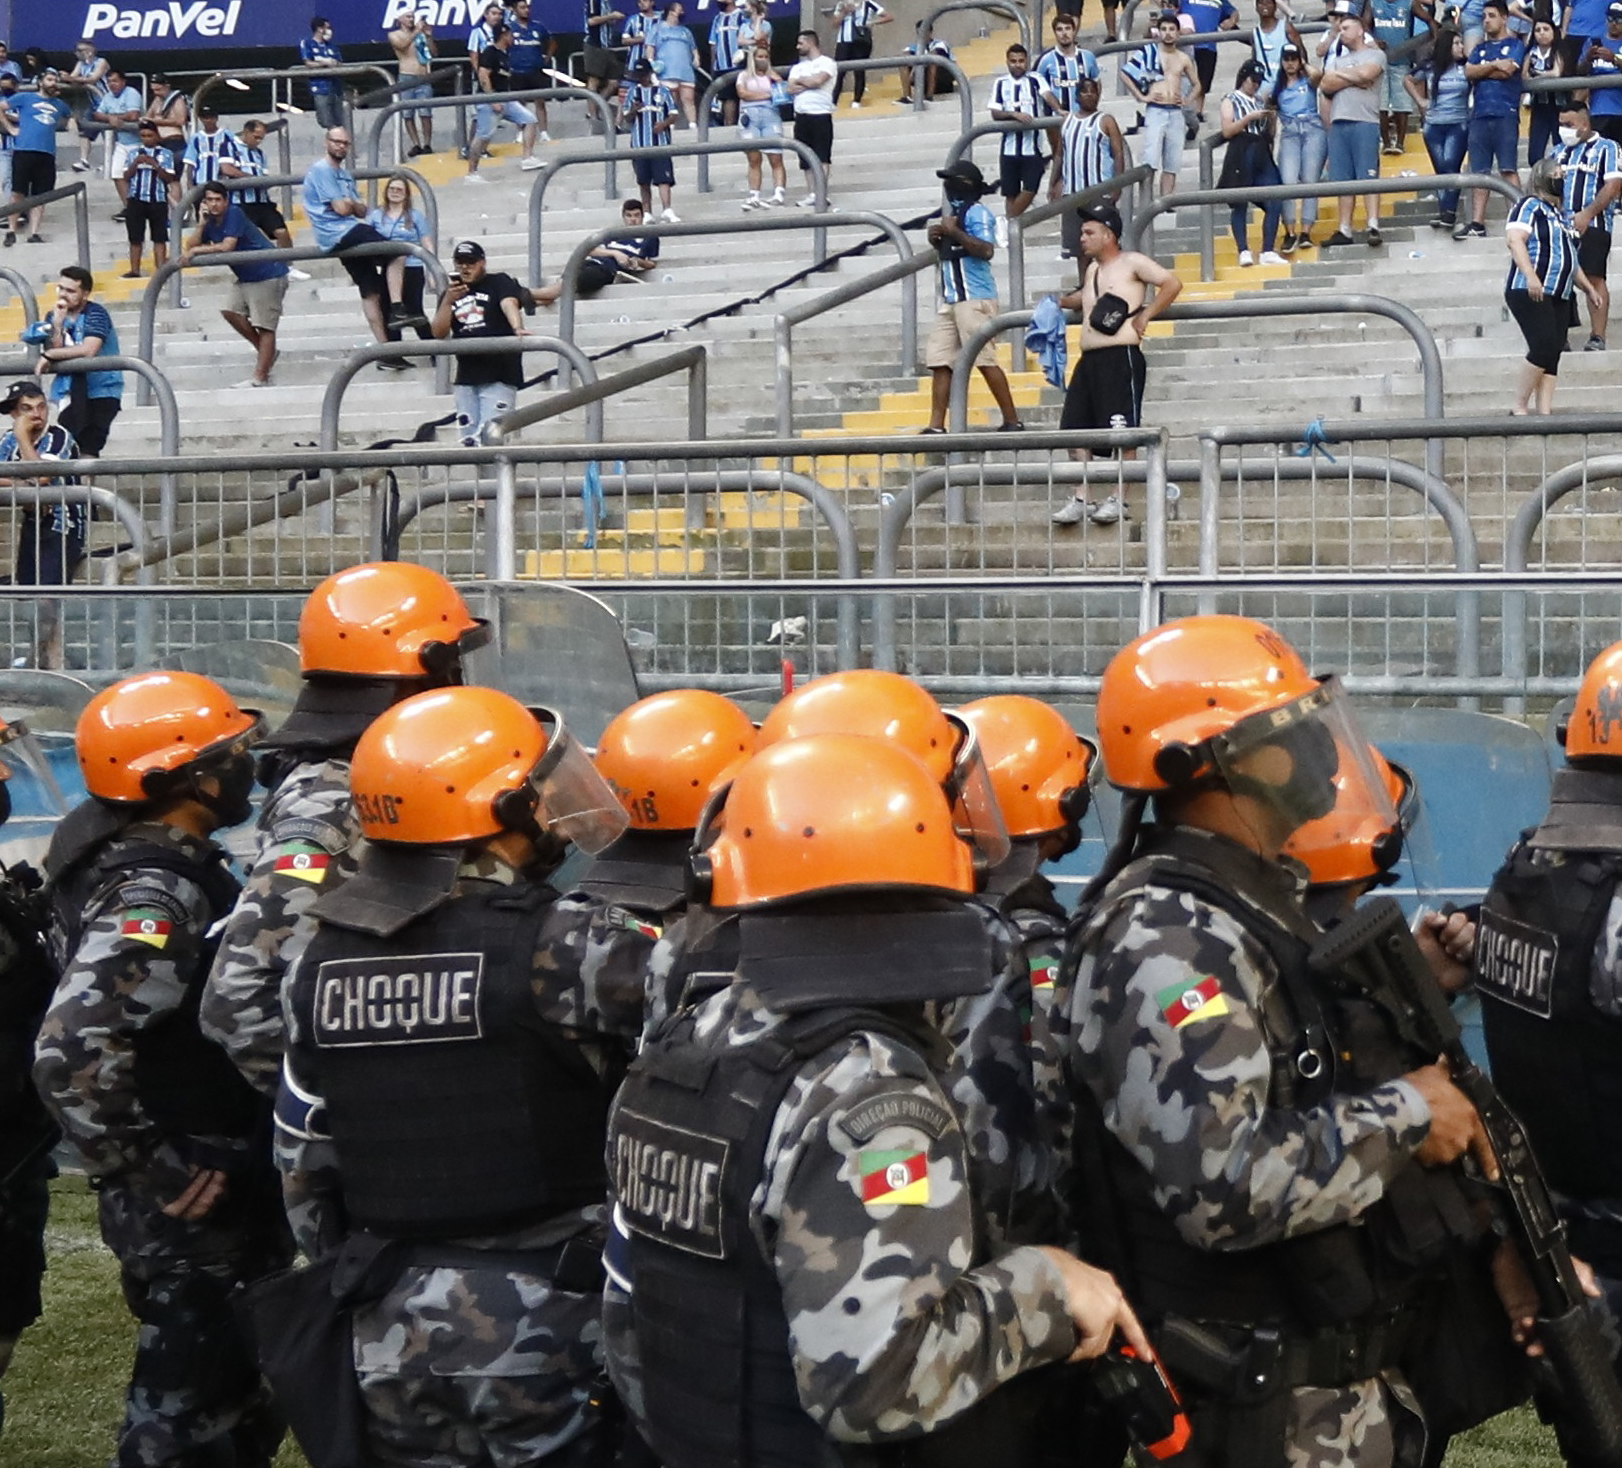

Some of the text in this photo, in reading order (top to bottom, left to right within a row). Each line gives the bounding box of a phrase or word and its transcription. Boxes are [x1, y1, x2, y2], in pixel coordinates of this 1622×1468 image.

[83, 0, 242, 39] PanVel
[1479, 925, 1552, 1002] CHOQUE
[321, 970, 474, 1046] CHOQUE
[850, 1099, 945, 1133] DIREÇÃO POLICIAL
[615, 1135, 720, 1236] CHOQUE
